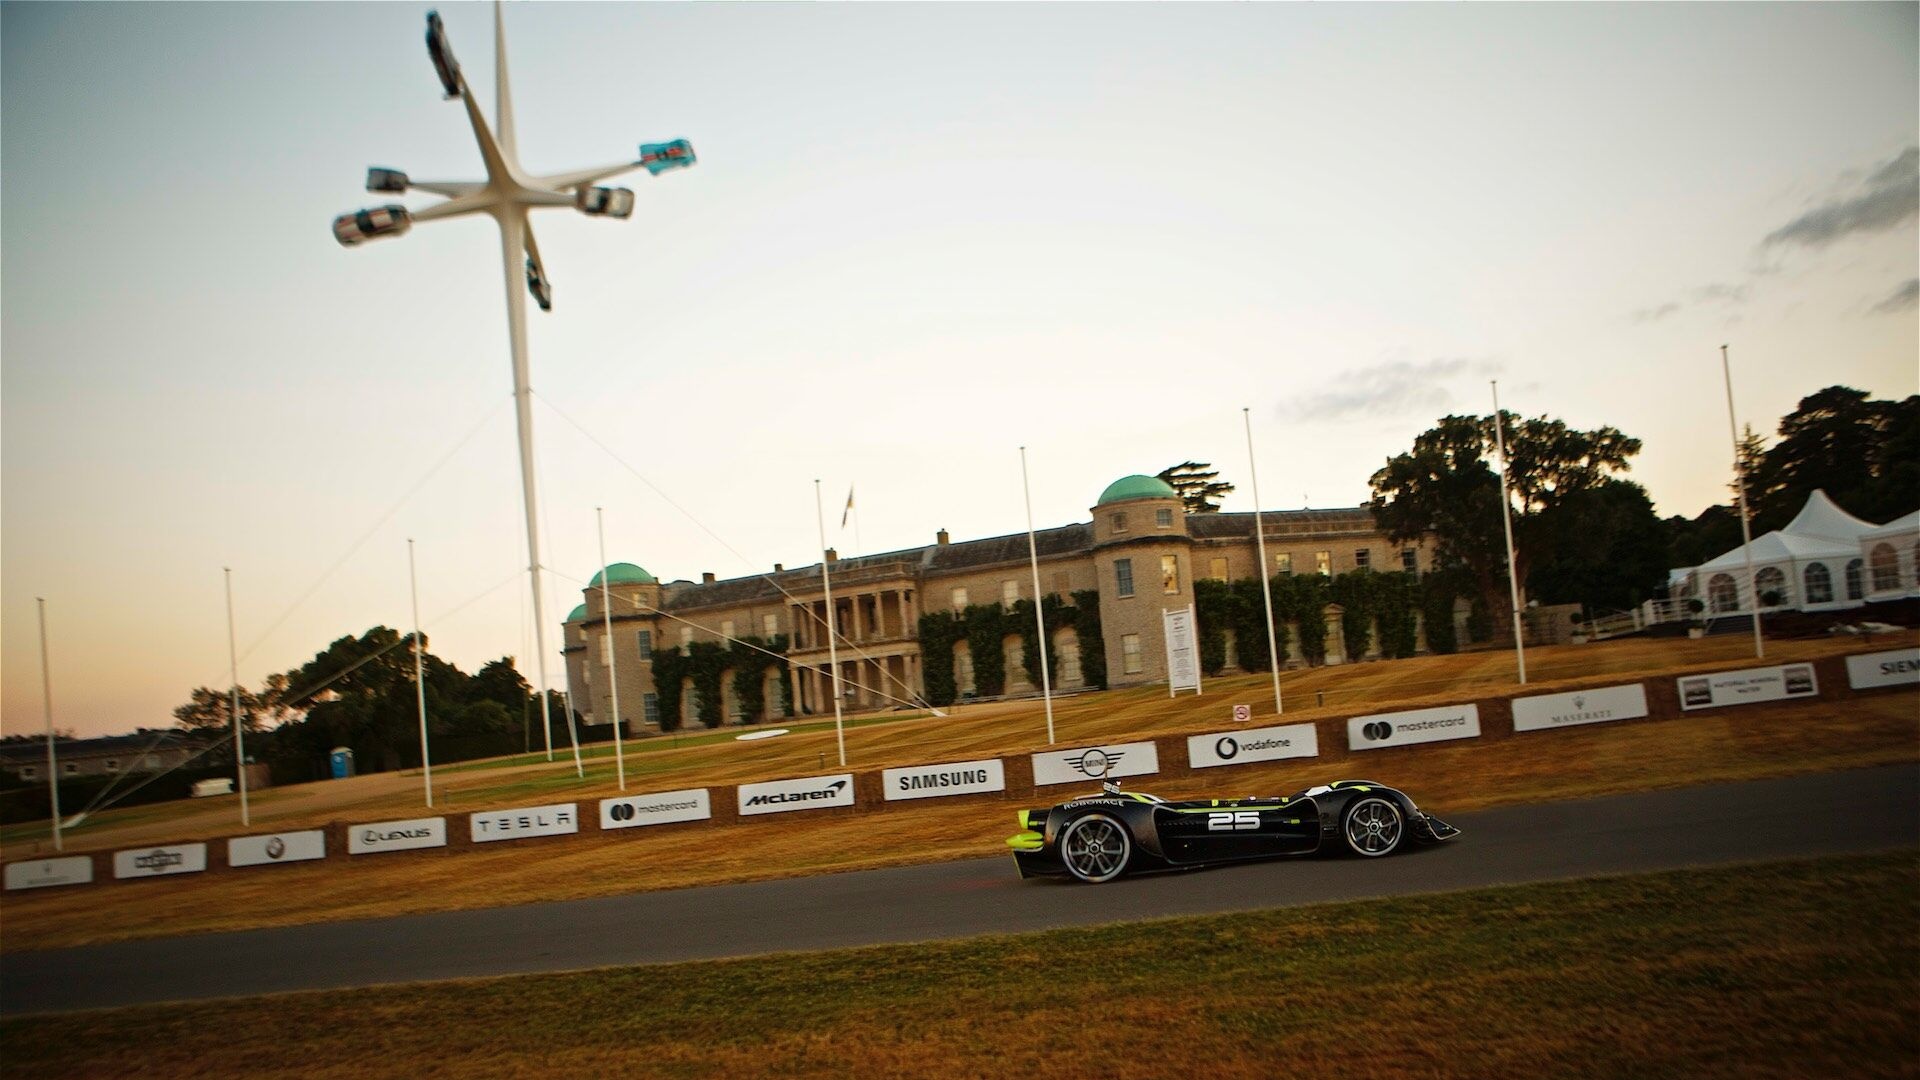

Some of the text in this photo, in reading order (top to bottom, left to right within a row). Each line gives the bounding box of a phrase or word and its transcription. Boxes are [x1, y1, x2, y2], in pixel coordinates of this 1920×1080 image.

[1551, 710, 1612, 722] MASERATI
[1397, 716, 1465, 732] mastercard
[1240, 739, 1290, 751] vodafone
[1085, 759, 1105, 767] MINI
[900, 769, 987, 790] SAMSUNG
[745, 789, 836, 806] McLaren
[1063, 798, 1124, 810] ROBORACE
[638, 799, 698, 814] mastercard
[478, 812, 571, 832] TESLA
[1208, 811, 1260, 831] 25
[379, 827, 432, 841] LEXUS
